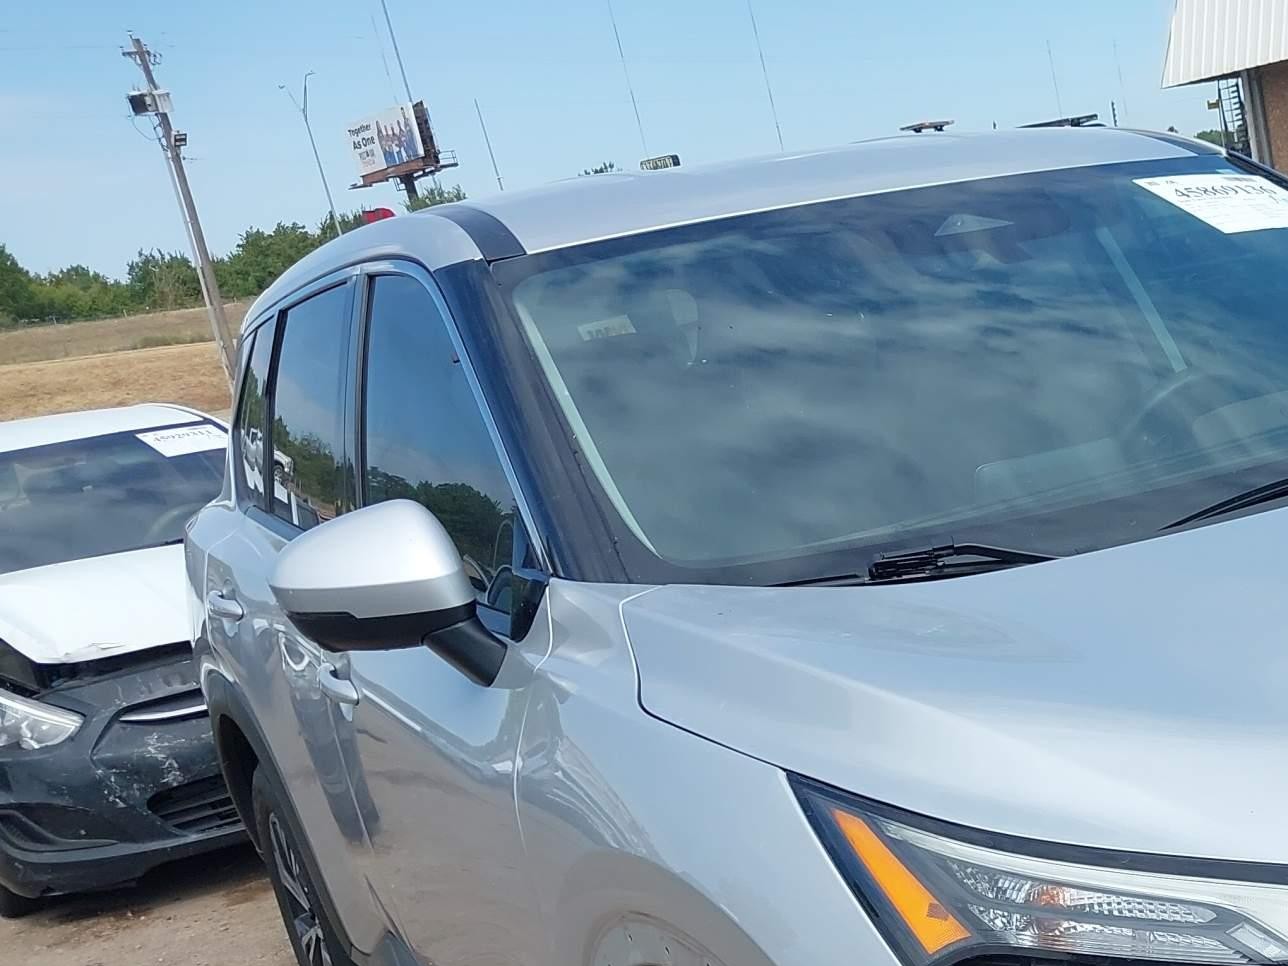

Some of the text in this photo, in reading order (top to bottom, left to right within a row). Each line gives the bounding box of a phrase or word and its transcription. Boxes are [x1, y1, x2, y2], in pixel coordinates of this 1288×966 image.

[348, 124, 371, 137] Together
[353, 136, 375, 151] As One
[1174, 184, 1277, 199] 45869136
